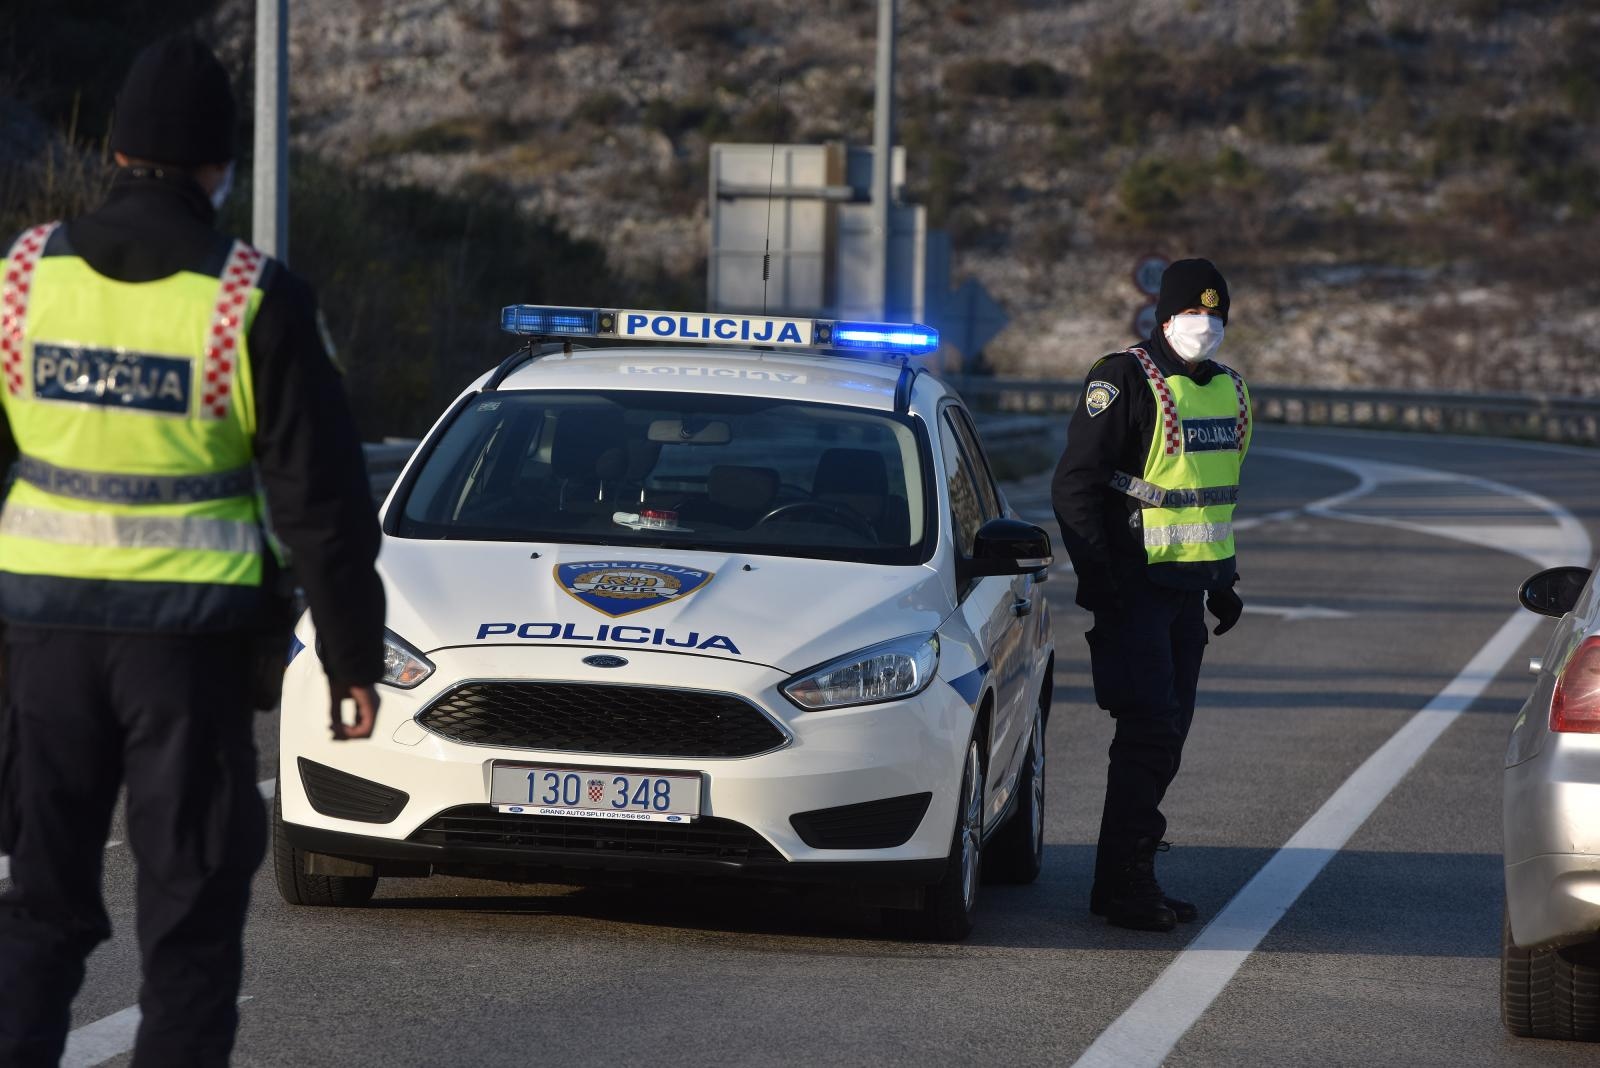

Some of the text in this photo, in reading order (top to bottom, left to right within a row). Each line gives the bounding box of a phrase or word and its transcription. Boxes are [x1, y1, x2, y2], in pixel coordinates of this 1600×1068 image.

[626, 314, 802, 344] POLICIJA
[36, 356, 183, 401] POLICIJA
[54, 472, 163, 500] POLICIJA
[567, 562, 702, 578] POLICIJA
[595, 584, 657, 592] MUP
[476, 622, 741, 655] POLICIJA
[527, 772, 671, 811] 130 348
